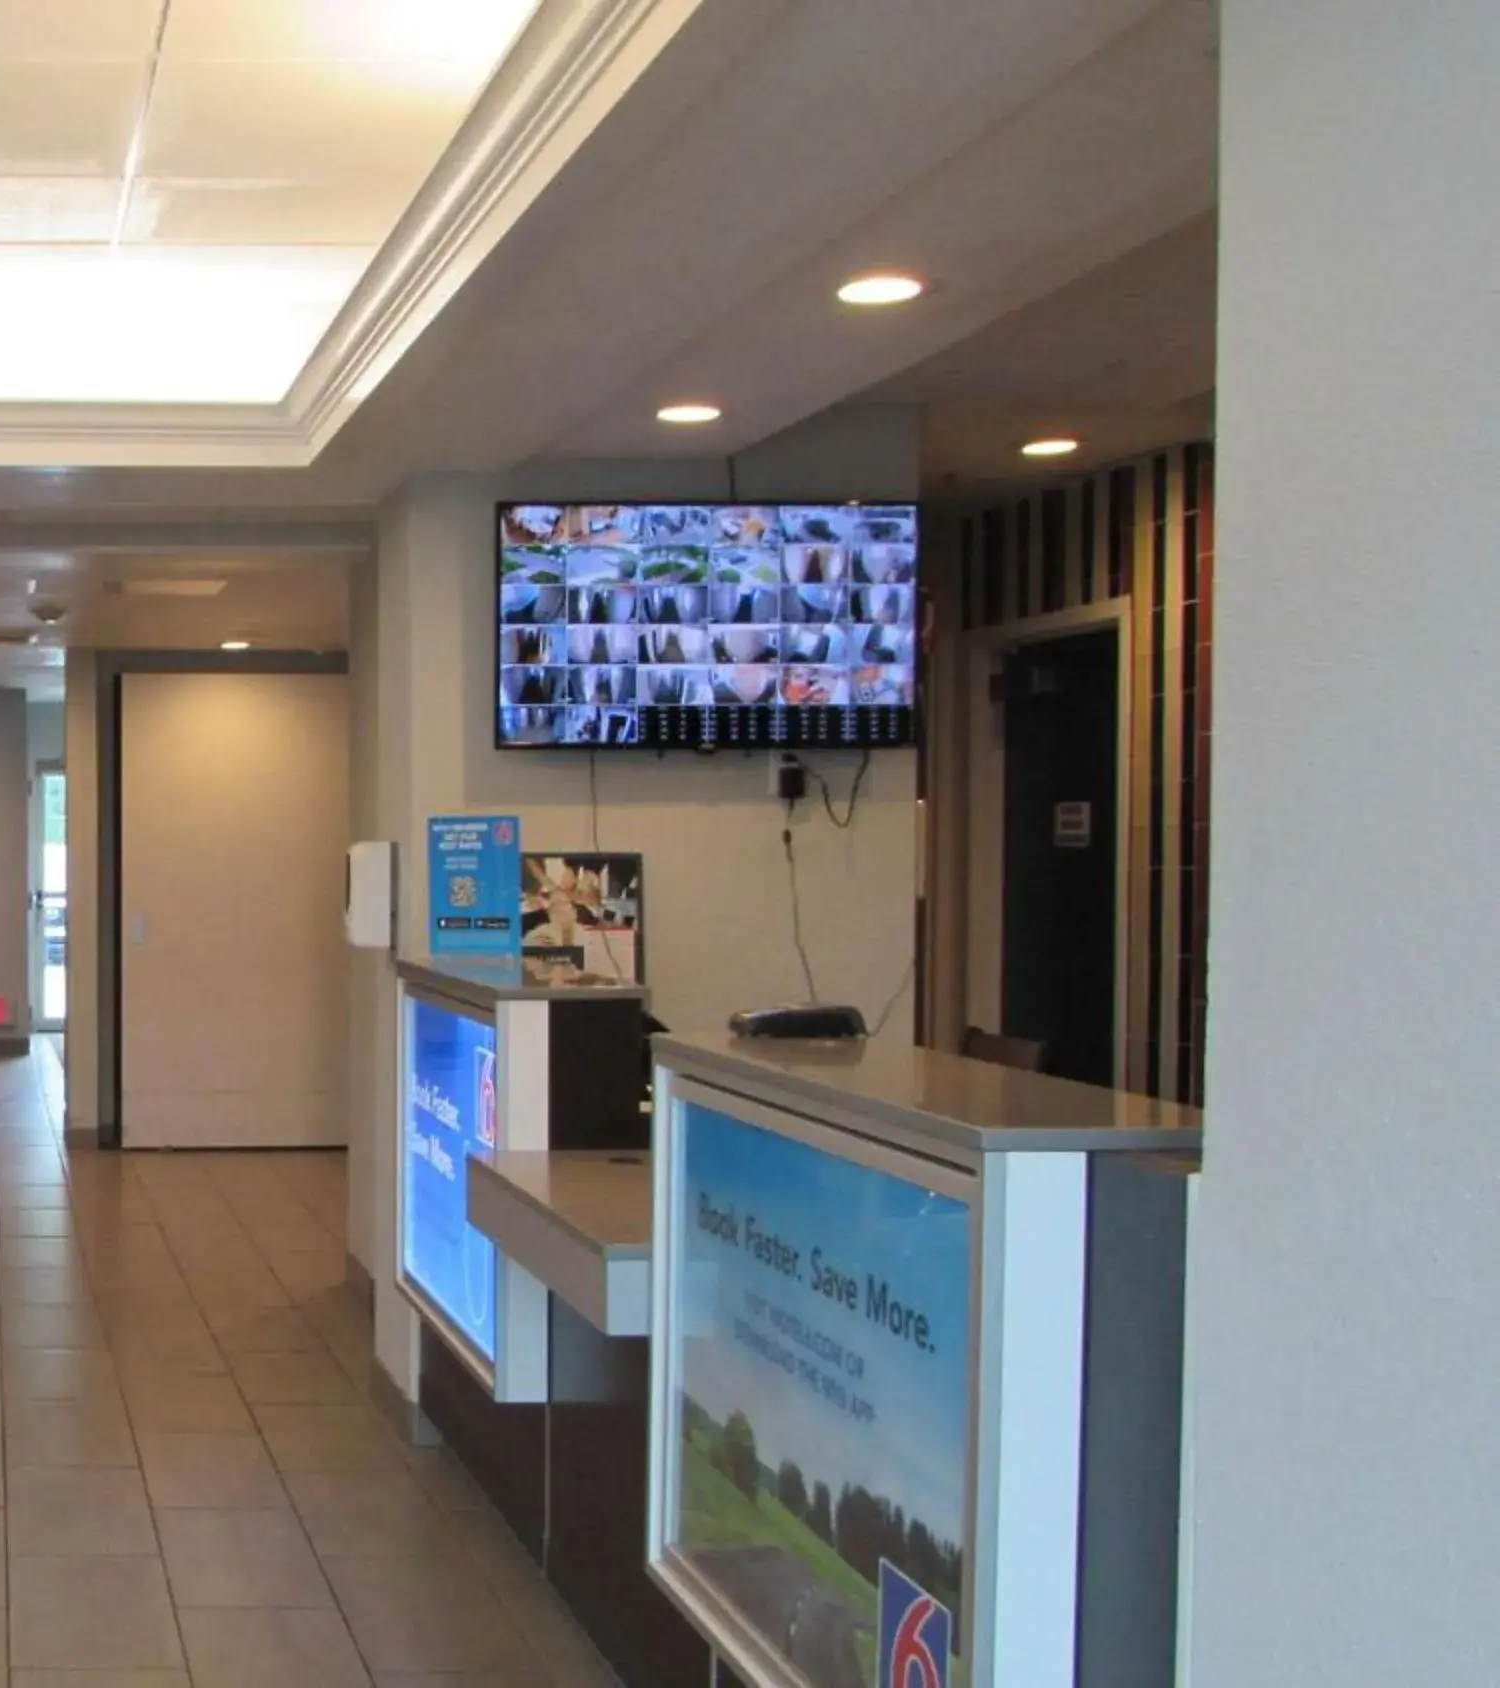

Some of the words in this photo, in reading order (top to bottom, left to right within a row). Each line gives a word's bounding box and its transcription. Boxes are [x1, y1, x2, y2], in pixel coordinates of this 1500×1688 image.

[698, 1191, 739, 1248] Book
[745, 1213, 802, 1282] Faster.
[810, 1246, 858, 1311] Save
[866, 1273, 937, 1355] More.
